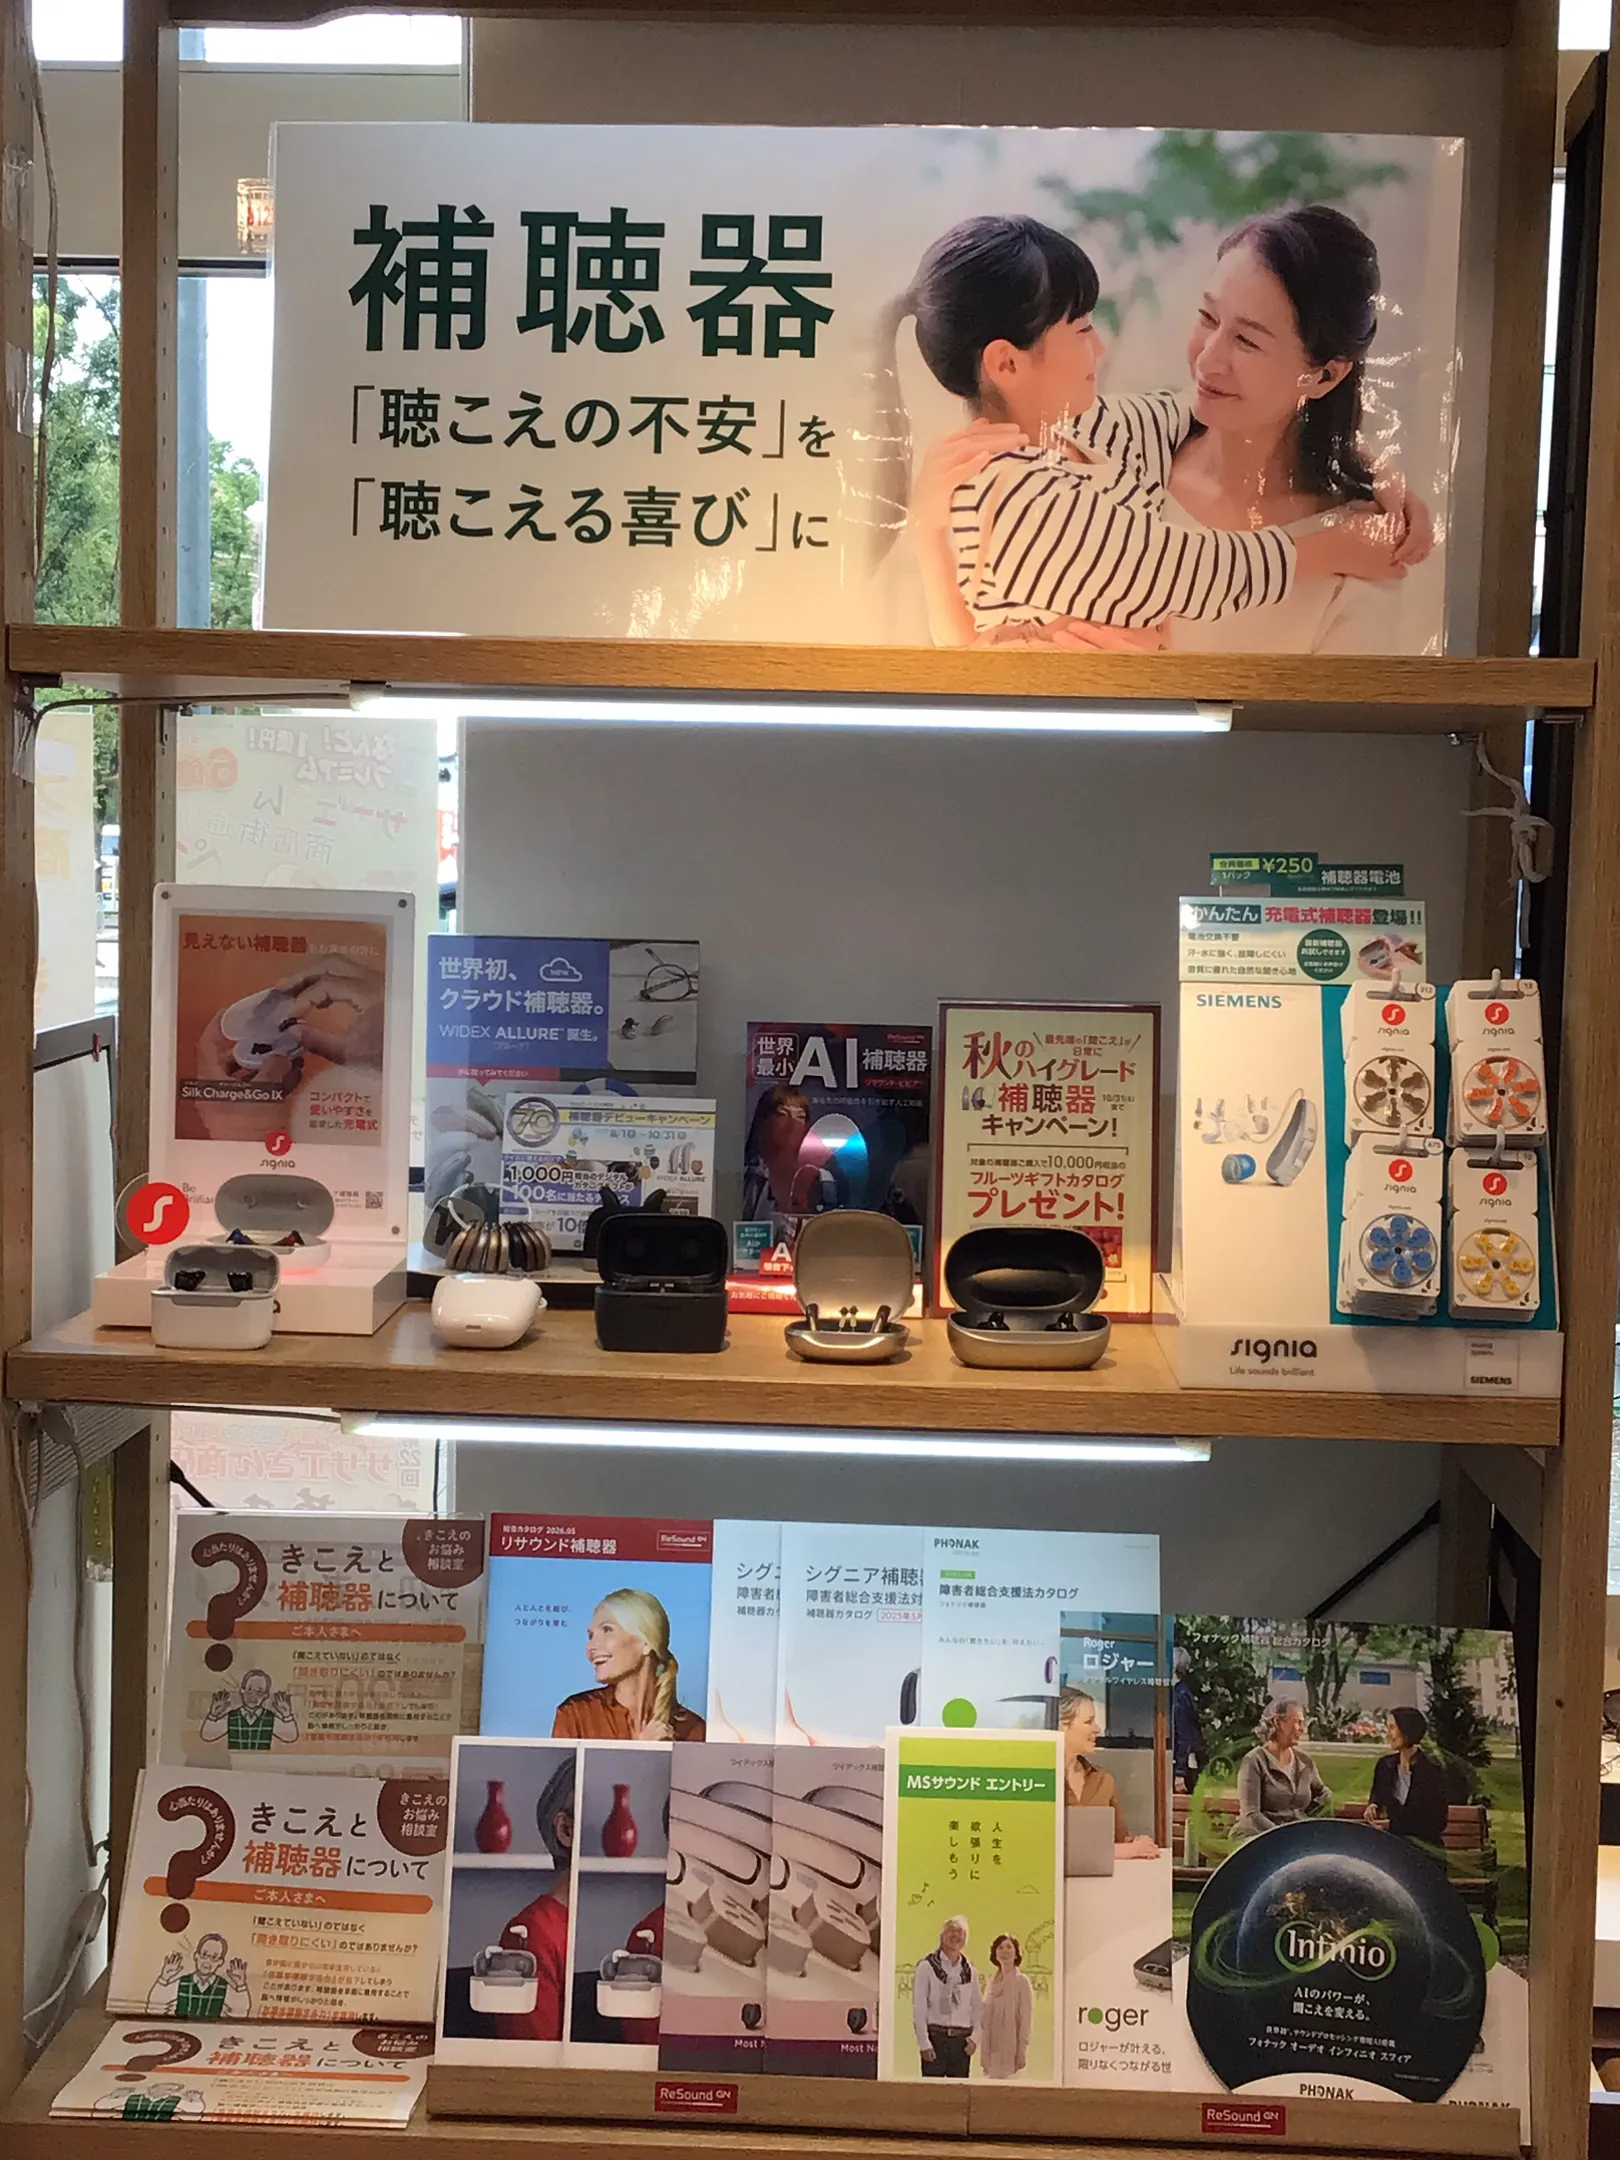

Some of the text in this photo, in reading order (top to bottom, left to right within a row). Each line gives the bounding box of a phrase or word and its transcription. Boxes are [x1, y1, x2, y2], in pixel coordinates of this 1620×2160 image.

[349, 204, 834, 358] 補聴器
[353, 385, 836, 459] 「聴こえの不安」を
[353, 476, 829, 551] 「聴こえる喜び」に
[1262, 857, 1313, 873] ¥250
[1320, 869, 1401, 885] 補聴器電池
[439, 956, 518, 981] 世界初、
[440, 988, 604, 1015] クラウド補聴器。
[1196, 993, 1282, 1009] SIEMENS
[439, 1025, 491, 1038] WIDEX
[1377, 1027, 1410, 1037] signia
[1481, 1027, 1515, 1038] signia
[757, 1037, 794, 1056] 世界
[789, 1036, 928, 1089] AI 補聴器
[1013, 1058, 1136, 1082] ハイグレード
[182, 1086, 201, 1099] Silk
[203, 1087, 269, 1101] Charge&Go
[998, 1082, 1095, 1115] 補聴器
[260, 1158, 296, 1170] signia
[510, 1166, 573, 1183] 1,000円
[970, 1171, 1125, 1189] フルーツギフトカタログ
[1384, 1184, 1417, 1194] signia
[1478, 1197, 1513, 1207] signia
[1230, 1339, 1318, 1364] signia
[1229, 1367, 1245, 1375] Life
[1247, 1368, 1280, 1376] sounds
[1470, 1376, 1513, 1386] SIEMENS
[424, 1529, 471, 1542] きこえの
[660, 1534, 695, 1543] ReSound
[428, 1544, 464, 1556] お悩み
[501, 1536, 617, 1555] リサウンド補聴器
[934, 1538, 980, 1550] PHONAK
[282, 1544, 394, 1574] きこえと
[427, 1557, 464, 1571] 相談室
[806, 1565, 923, 1587] シグニア補聴
[278, 1580, 459, 1613] 補聴器について
[737, 1587, 780, 1601] 障害者
[939, 1584, 1080, 1600] 障害者総合支援法カタログ
[806, 1608, 872, 1620] 補聴器カタログ
[291, 1625, 362, 1637] ご本人さまへ
[1083, 1637, 1116, 1652] Roger
[1083, 1654, 1154, 1672] ロジャー
[906, 1775, 1047, 1793] MSサウンド エントリー
[400, 1792, 447, 1806] きこえの
[251, 1802, 367, 1838] きこえと
[402, 1807, 440, 1821] お悩み
[400, 1822, 438, 1838] 相談室
[948, 1820, 960, 1881] 楽しもう
[969, 1820, 982, 1882] 欲張りに
[992, 1820, 1003, 1866] 人生を
[241, 1840, 430, 1880] 補聴器について
[253, 1889, 326, 1904] ご本人さまへ
[1287, 1929, 1386, 1969] Infinio
[1079, 2007, 1149, 2032] roger
[734, 2039, 758, 2050] Most
[841, 2044, 864, 2054] Most
[1290, 2040, 1324, 2055] オーデオ
[206, 2051, 408, 2071] 補聴器について
[1078, 2058, 1172, 2074] 限りなくつながる世
[660, 2087, 731, 2101] ReSound GN
[1300, 2083, 1354, 2100] PHONAK
[1207, 2108, 1279, 2123] ReSound GN
